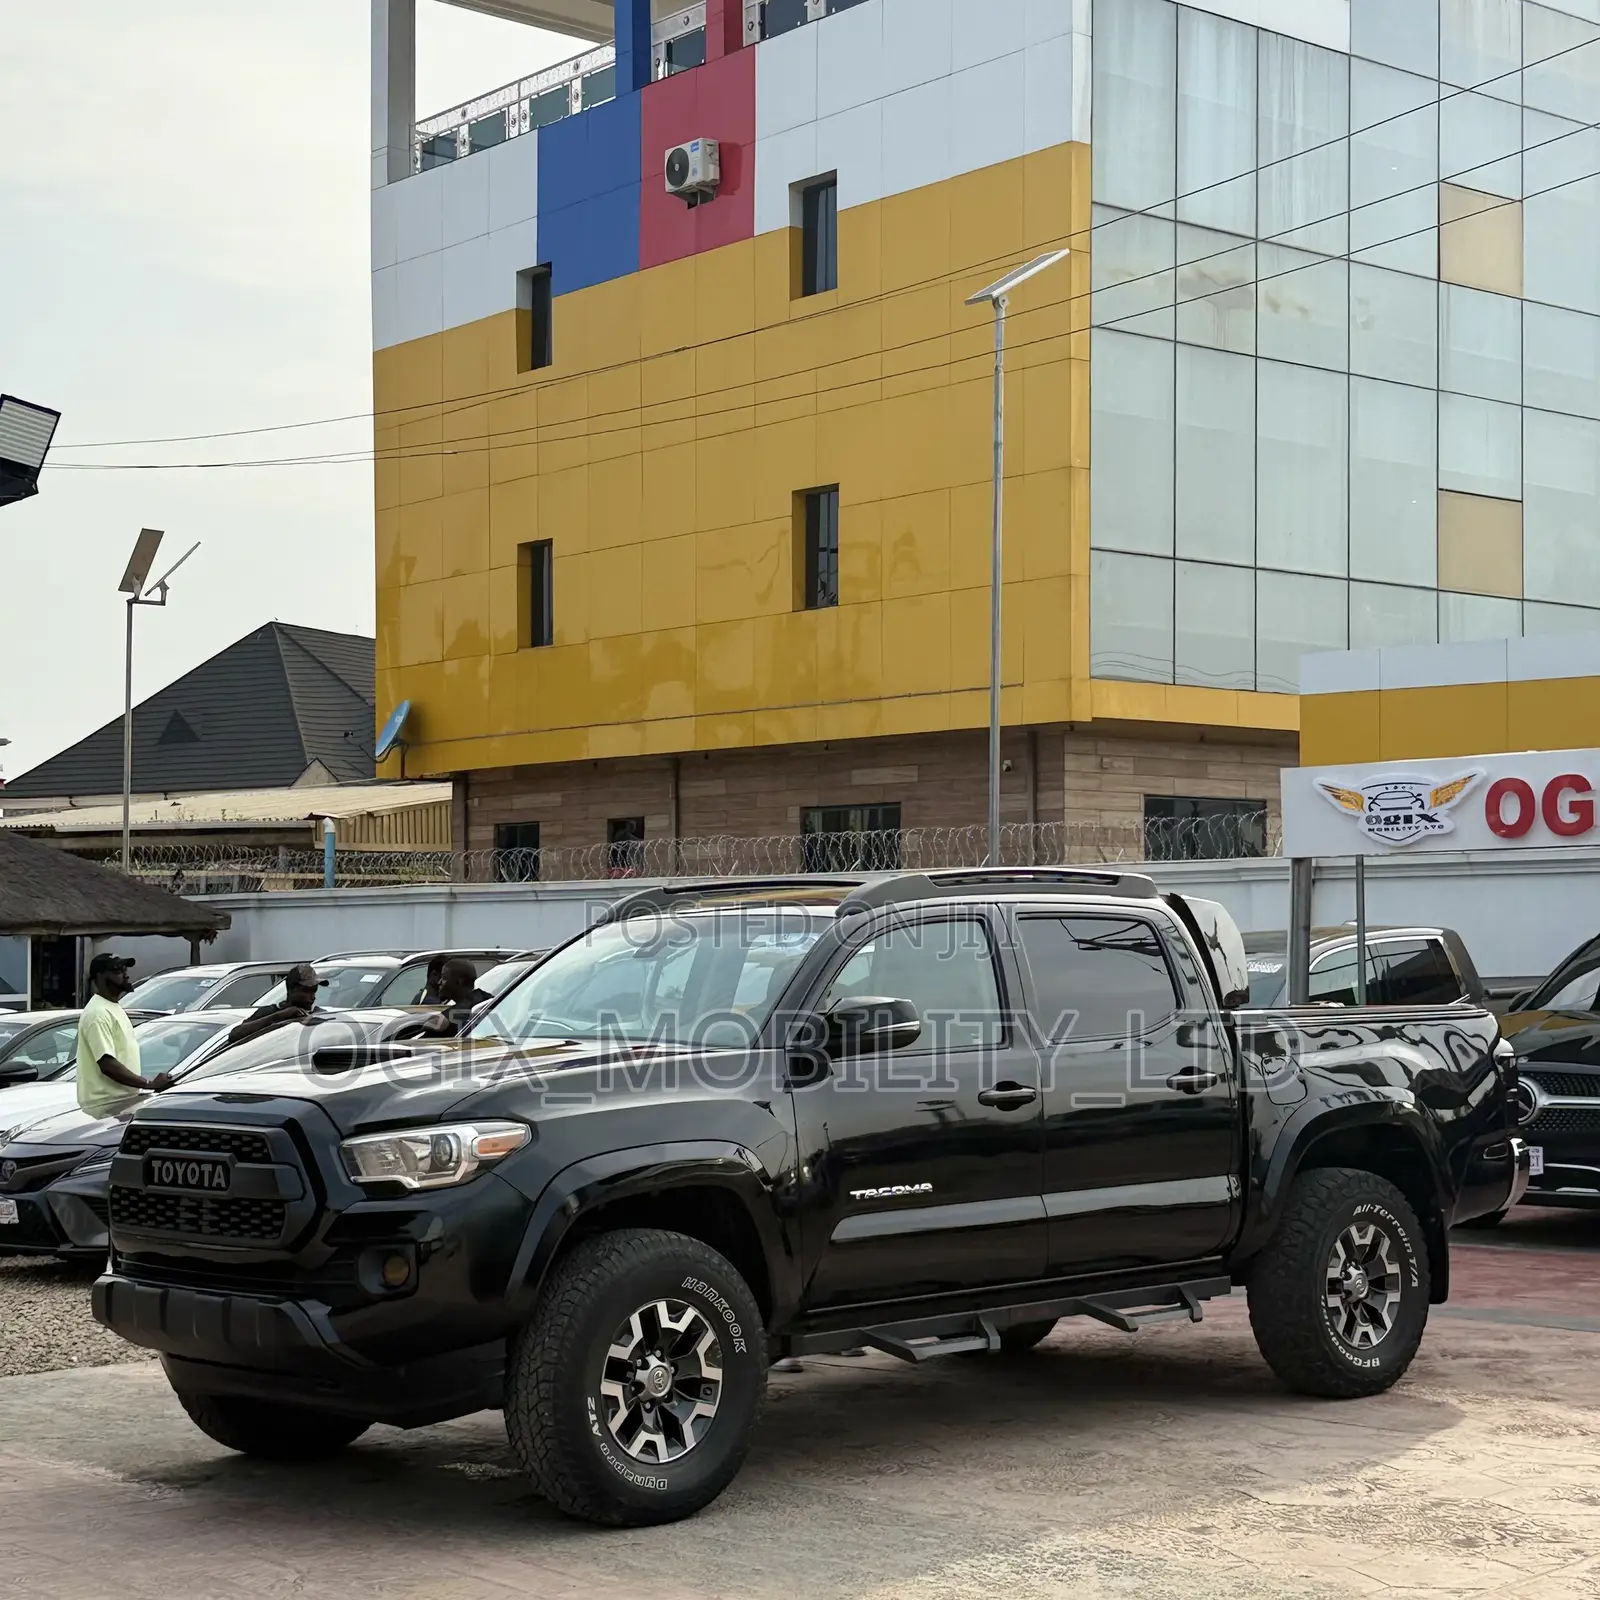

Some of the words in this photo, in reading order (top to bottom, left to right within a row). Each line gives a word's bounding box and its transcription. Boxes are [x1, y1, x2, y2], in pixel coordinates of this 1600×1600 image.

[1485, 774, 1594, 838] OG
[152, 1160, 226, 1188] TOYOTA
[849, 1182, 933, 1200] TACOMA
